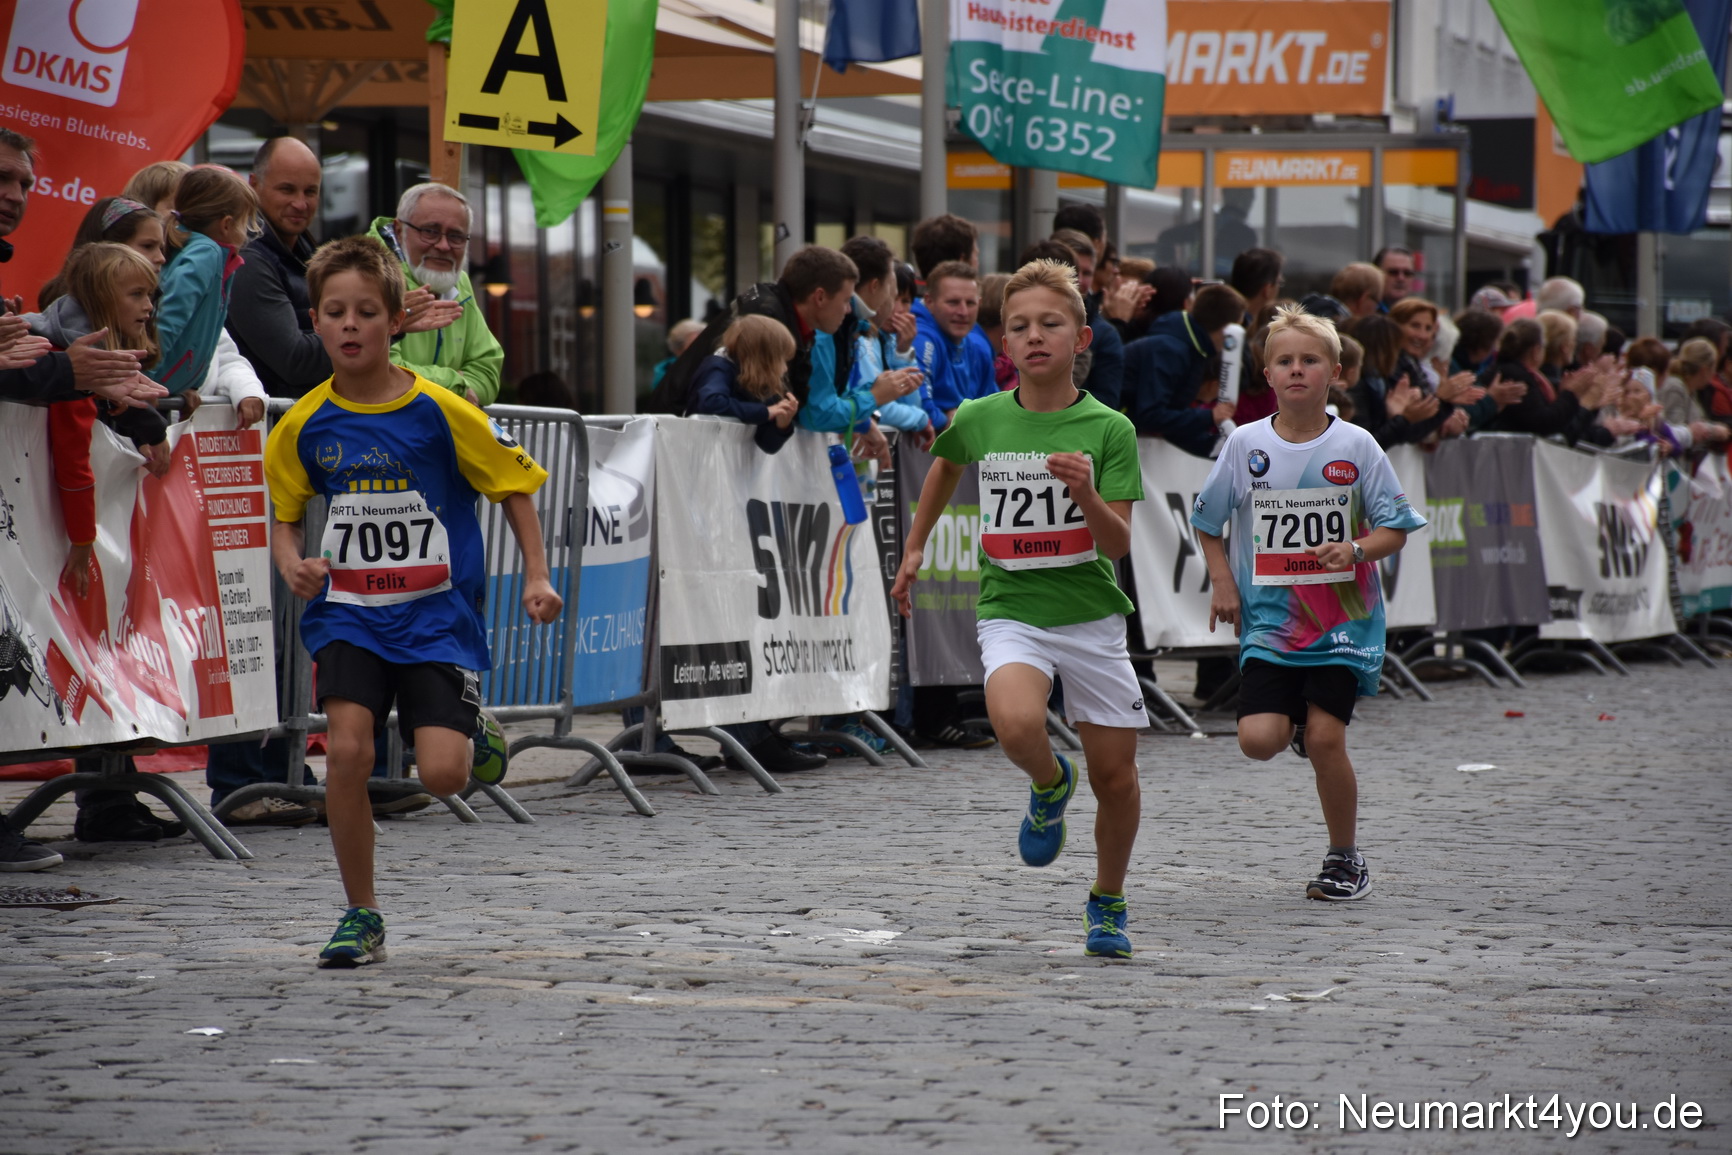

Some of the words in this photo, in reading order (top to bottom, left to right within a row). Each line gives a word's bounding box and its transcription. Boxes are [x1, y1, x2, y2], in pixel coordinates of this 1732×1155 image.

[480, 0, 568, 103] A
[13, 46, 113, 93] DKMS
[65, 117, 151, 150] Blutkrebs.
[1025, 116, 1116, 162] 6352
[321, 455, 337, 463] Jahre
[982, 471, 1014, 482] PARTL
[331, 505, 359, 516] PARTL
[363, 503, 421, 516] Neumarkt
[990, 486, 1084, 528] 7212
[1254, 500, 1283, 509] PARTL
[1285, 498, 1335, 508] Neumarkt
[1261, 511, 1345, 548] 7209
[333, 518, 434, 563] 7097
[1013, 539, 1061, 555] Kenny
[438, 554, 444, 562] K
[1284, 558, 1323, 572] Jonas
[366, 574, 407, 590] Felix
[1330, 631, 1353, 645] 16.
